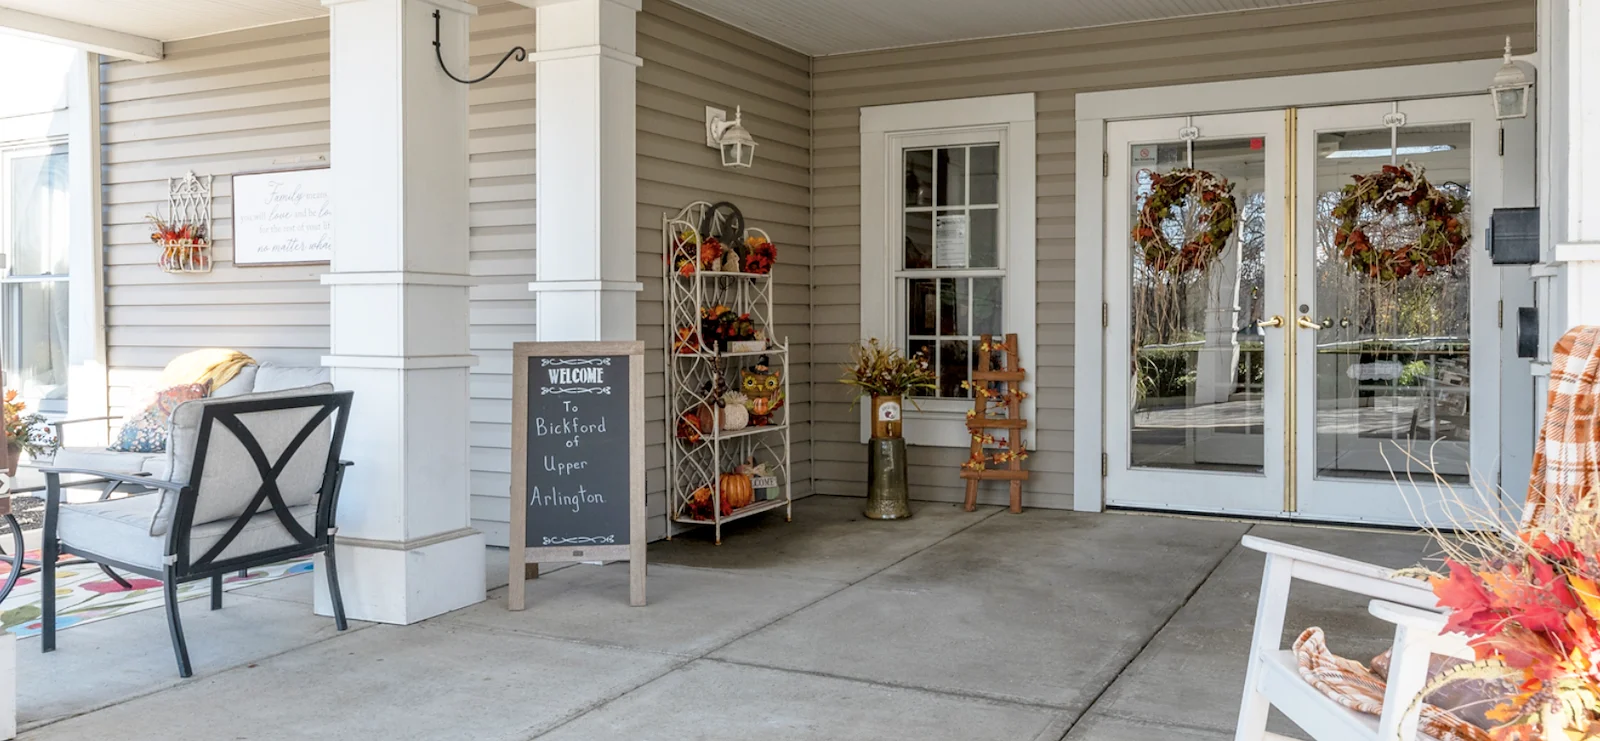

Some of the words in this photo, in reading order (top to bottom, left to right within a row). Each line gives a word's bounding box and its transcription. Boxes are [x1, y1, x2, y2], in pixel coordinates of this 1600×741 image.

[264, 180, 305, 206] Family
[268, 203, 292, 221] love
[257, 245, 269, 253] no
[271, 237, 306, 253] matter
[548, 367, 604, 385] WELCOME
[563, 400, 578, 413] To
[536, 416, 607, 436] Bickford
[565, 435, 580, 448] of
[543, 455, 588, 476] Upper
[530, 484, 604, 513] Arlington
